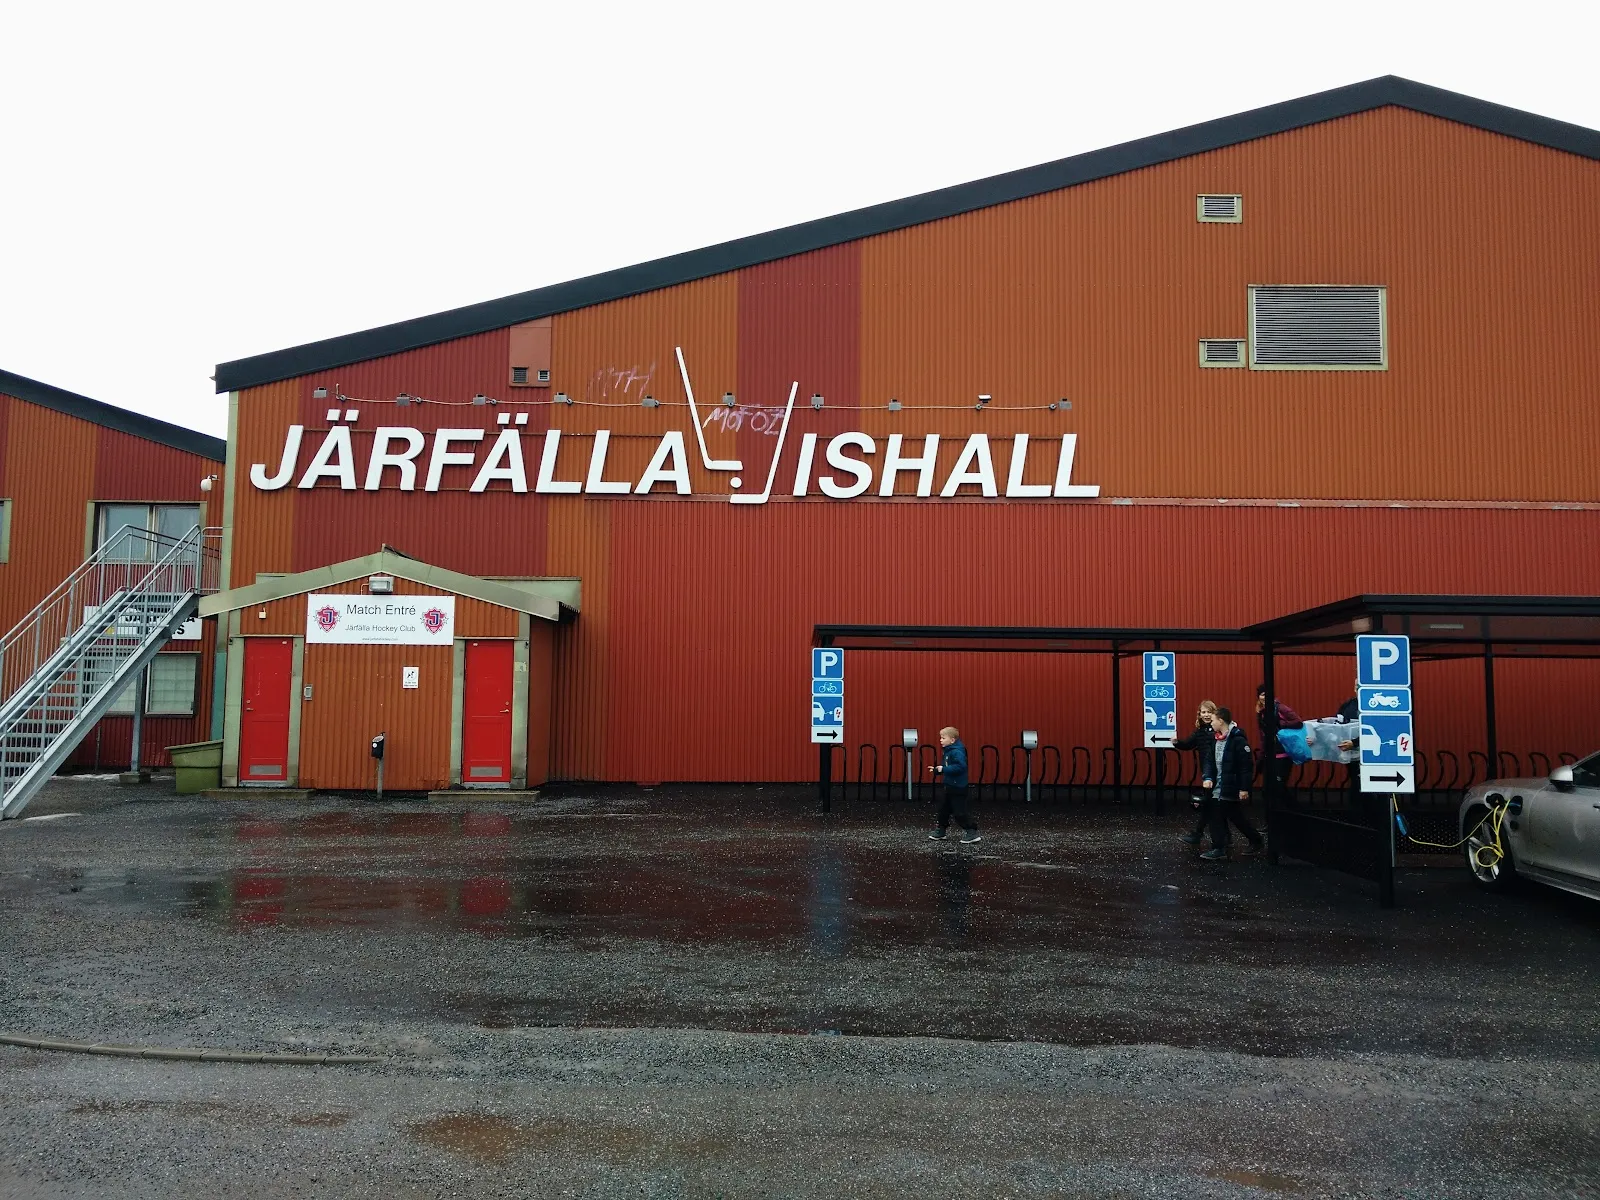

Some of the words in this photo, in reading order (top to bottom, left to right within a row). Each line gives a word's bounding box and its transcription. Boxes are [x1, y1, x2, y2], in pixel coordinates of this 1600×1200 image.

[249, 409, 692, 495] JÄRFÄLLA
[792, 431, 1100, 499] ISHALL
[346, 604, 381, 615] Match
[385, 604, 416, 616] Entré
[372, 625, 398, 634] Hockey
[399, 625, 416, 633] Club
[820, 651, 838, 676] P
[1151, 655, 1170, 681] P
[1371, 641, 1400, 681] P
